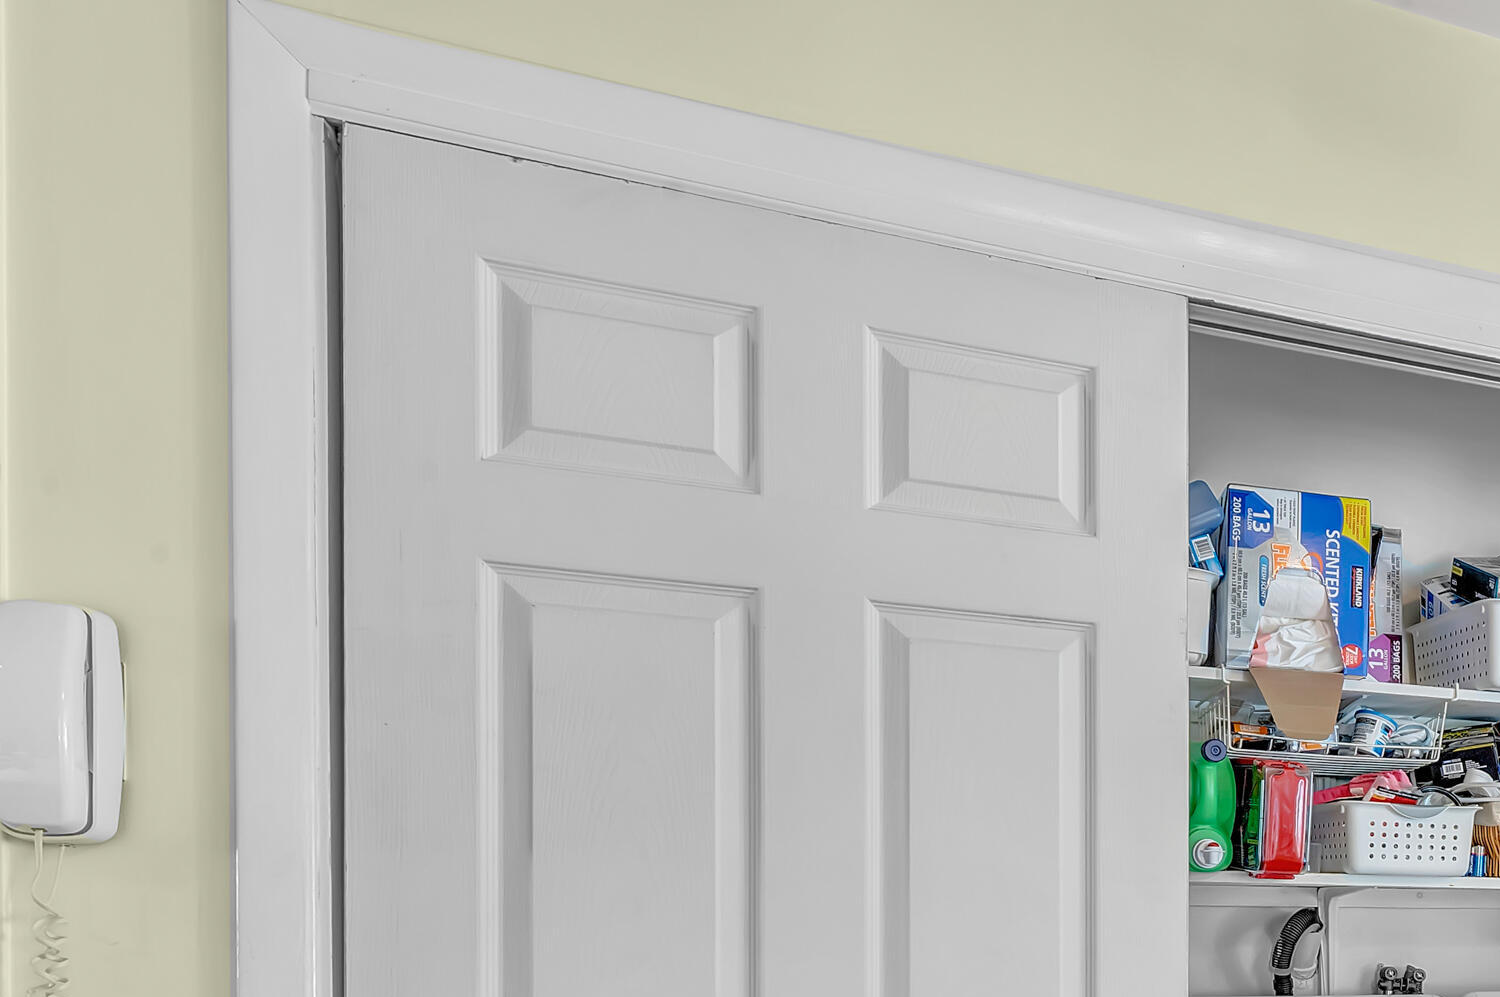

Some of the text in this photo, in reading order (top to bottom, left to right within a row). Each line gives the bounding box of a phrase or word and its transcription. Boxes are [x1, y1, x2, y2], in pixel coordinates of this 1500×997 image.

[1232, 496, 1242, 514] 200
[1232, 515, 1241, 541] BAGS
[1252, 509, 1271, 534] 13
[1325, 529, 1340, 597] SCENTED
[1355, 567, 1364, 608] KIRKLAND
[1346, 646, 1358, 655] 7
[1369, 648, 1384, 669] 13
[1392, 640, 1400, 663] BAGS
[1392, 663, 1400, 681] 200
